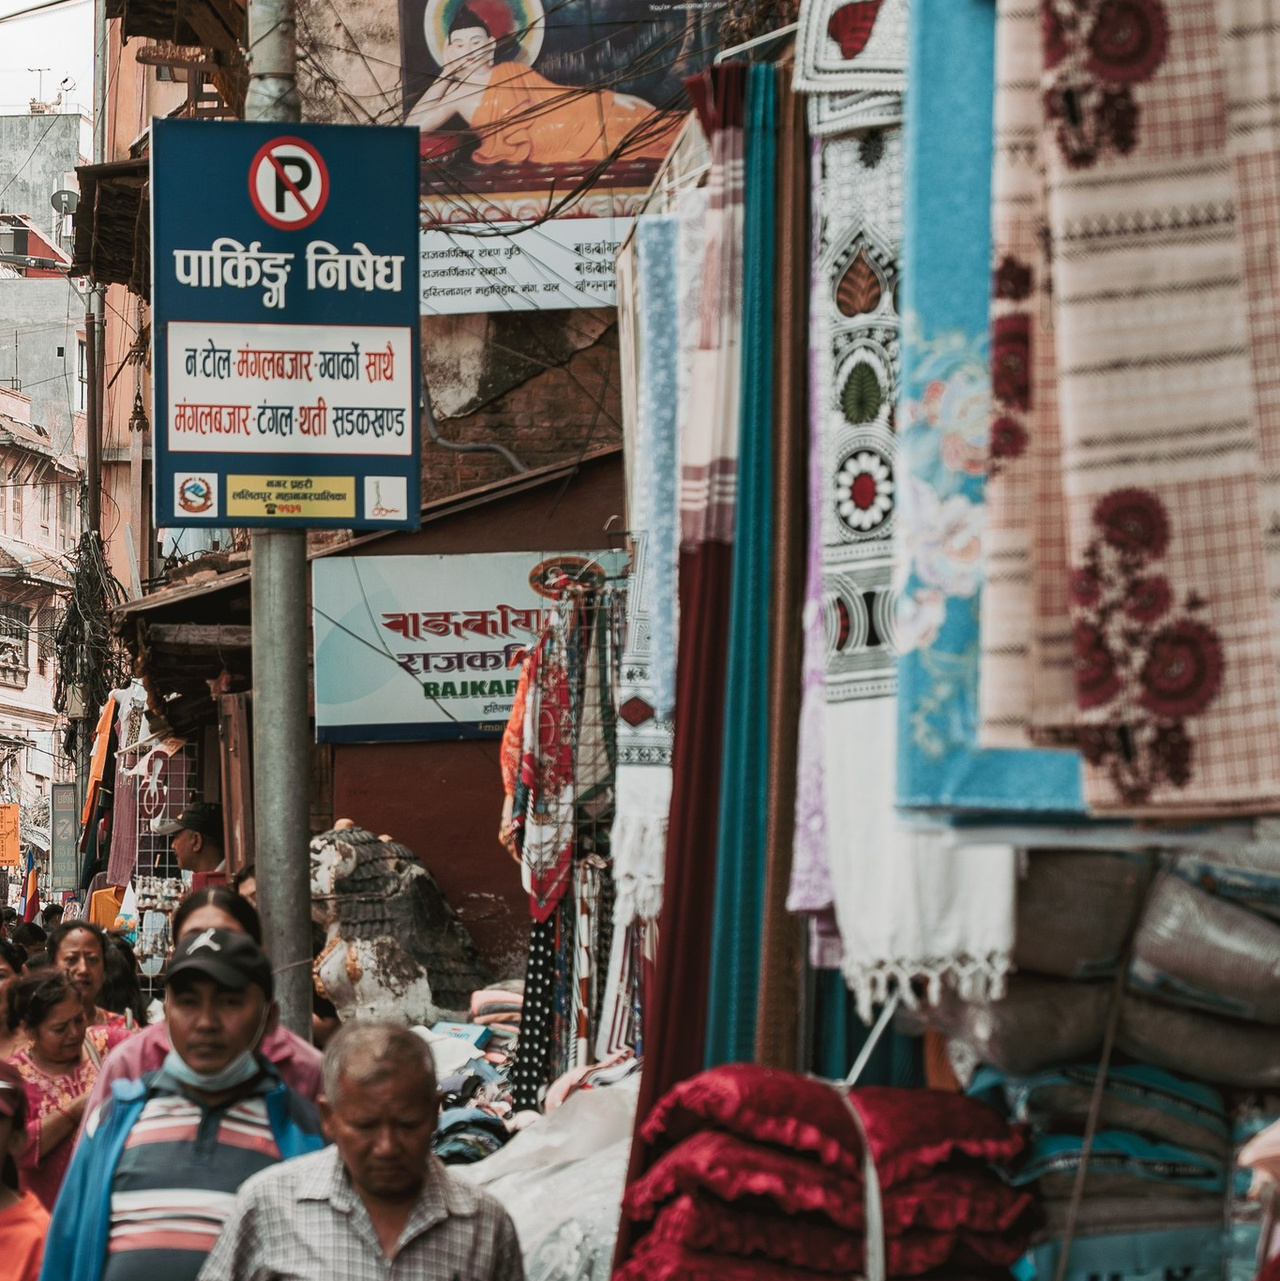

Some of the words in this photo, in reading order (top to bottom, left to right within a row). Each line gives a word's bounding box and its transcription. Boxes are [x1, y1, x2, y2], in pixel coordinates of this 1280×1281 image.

[173, 237, 294, 309] पार्किङ्ग
[306, 240, 405, 293] निषेध
[365, 340, 395, 383] साथै
[332, 406, 406, 438] सडकखण्ड
[232, 490, 272, 503] ललितपुर
[275, 490, 347, 502] महानगरपालिका
[266, 479, 287, 488] नगर
